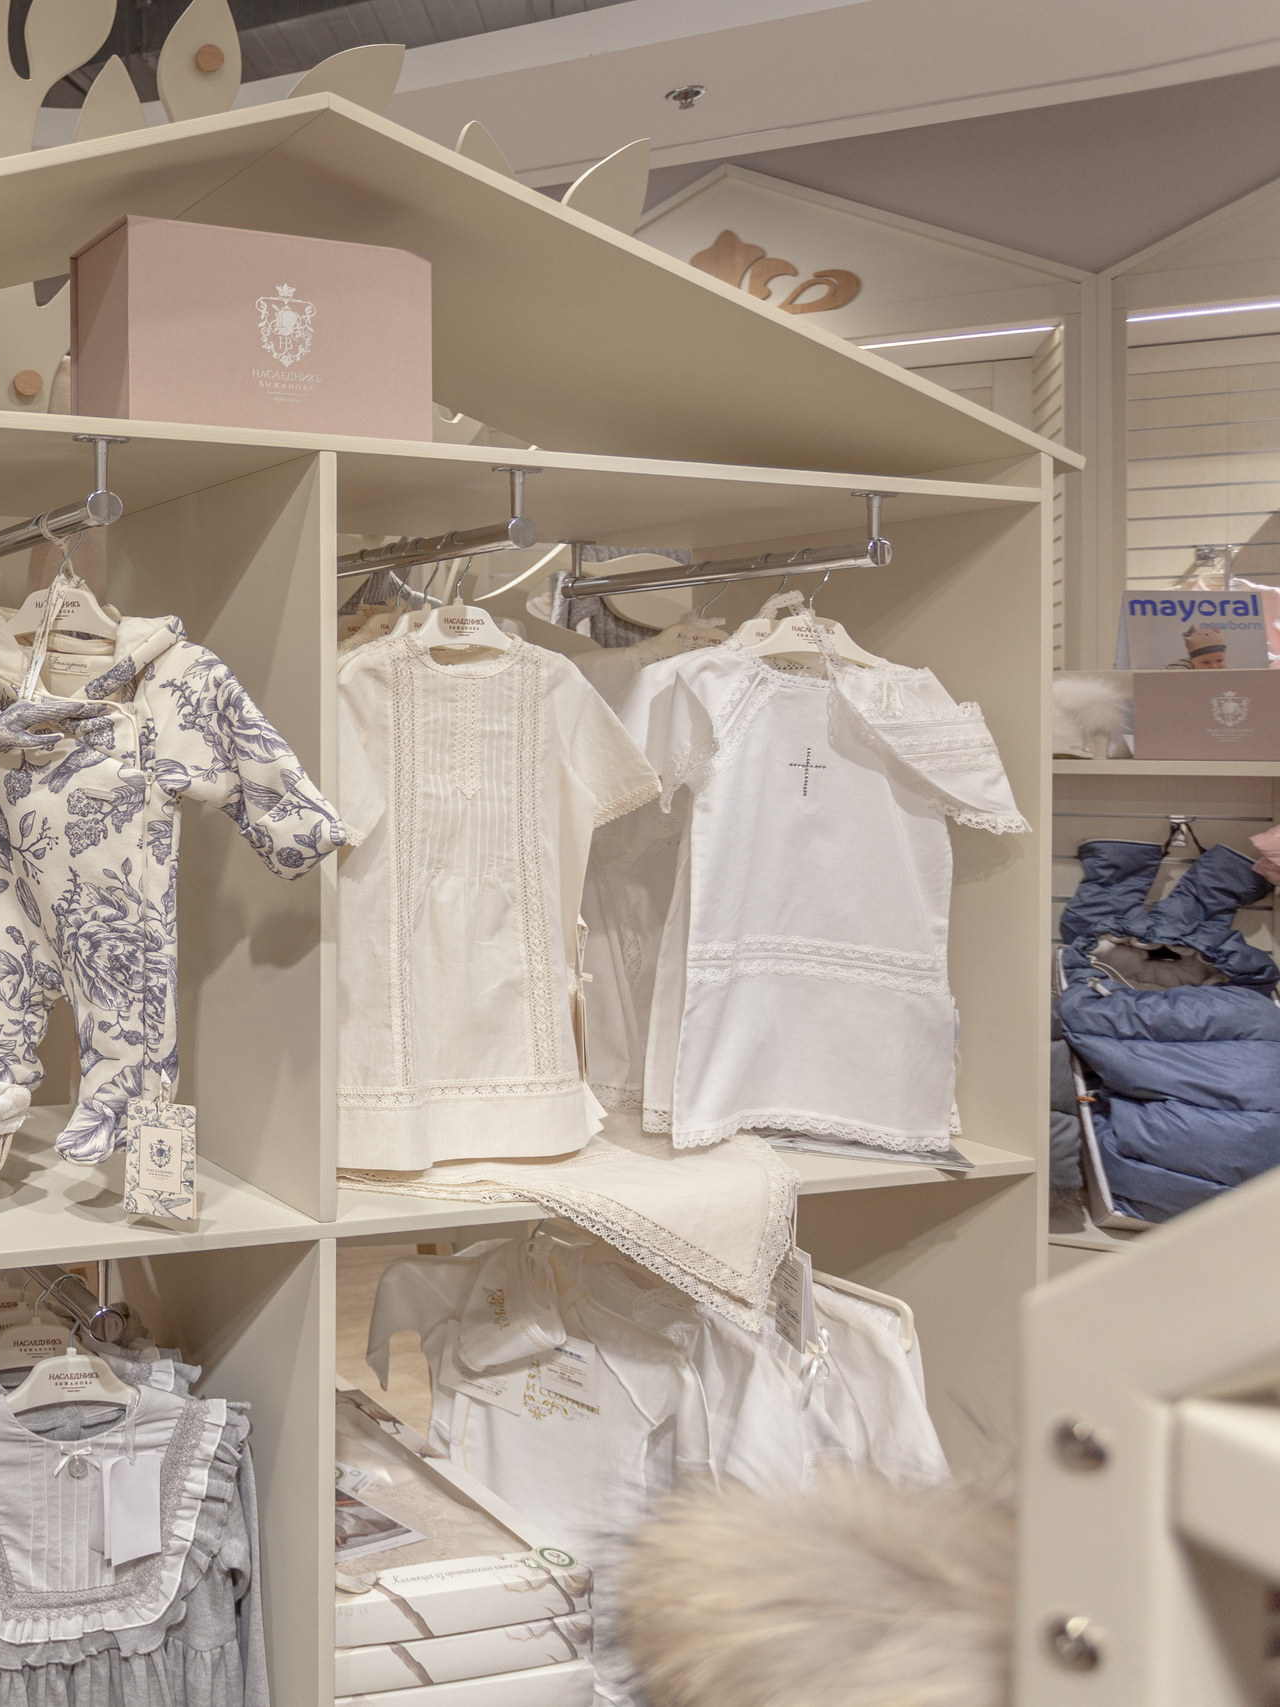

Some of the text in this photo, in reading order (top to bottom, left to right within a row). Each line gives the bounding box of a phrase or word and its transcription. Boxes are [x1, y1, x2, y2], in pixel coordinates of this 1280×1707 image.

[251, 368, 322, 384] НАСЛЕДНИКЪ
[259, 380, 314, 391] ВЫЖАНОВА
[1128, 594, 1259, 623] mayoral
[443, 617, 485, 626] НАСЛЕДНИКЪ
[1199, 620, 1263, 631] newborn
[13, 1338, 63, 1347] НАСЛЕДНИКЪ
[48, 1372, 100, 1381] НАСЛЕДНИКЪ
[392, 1573, 435, 1586] Коллекция
